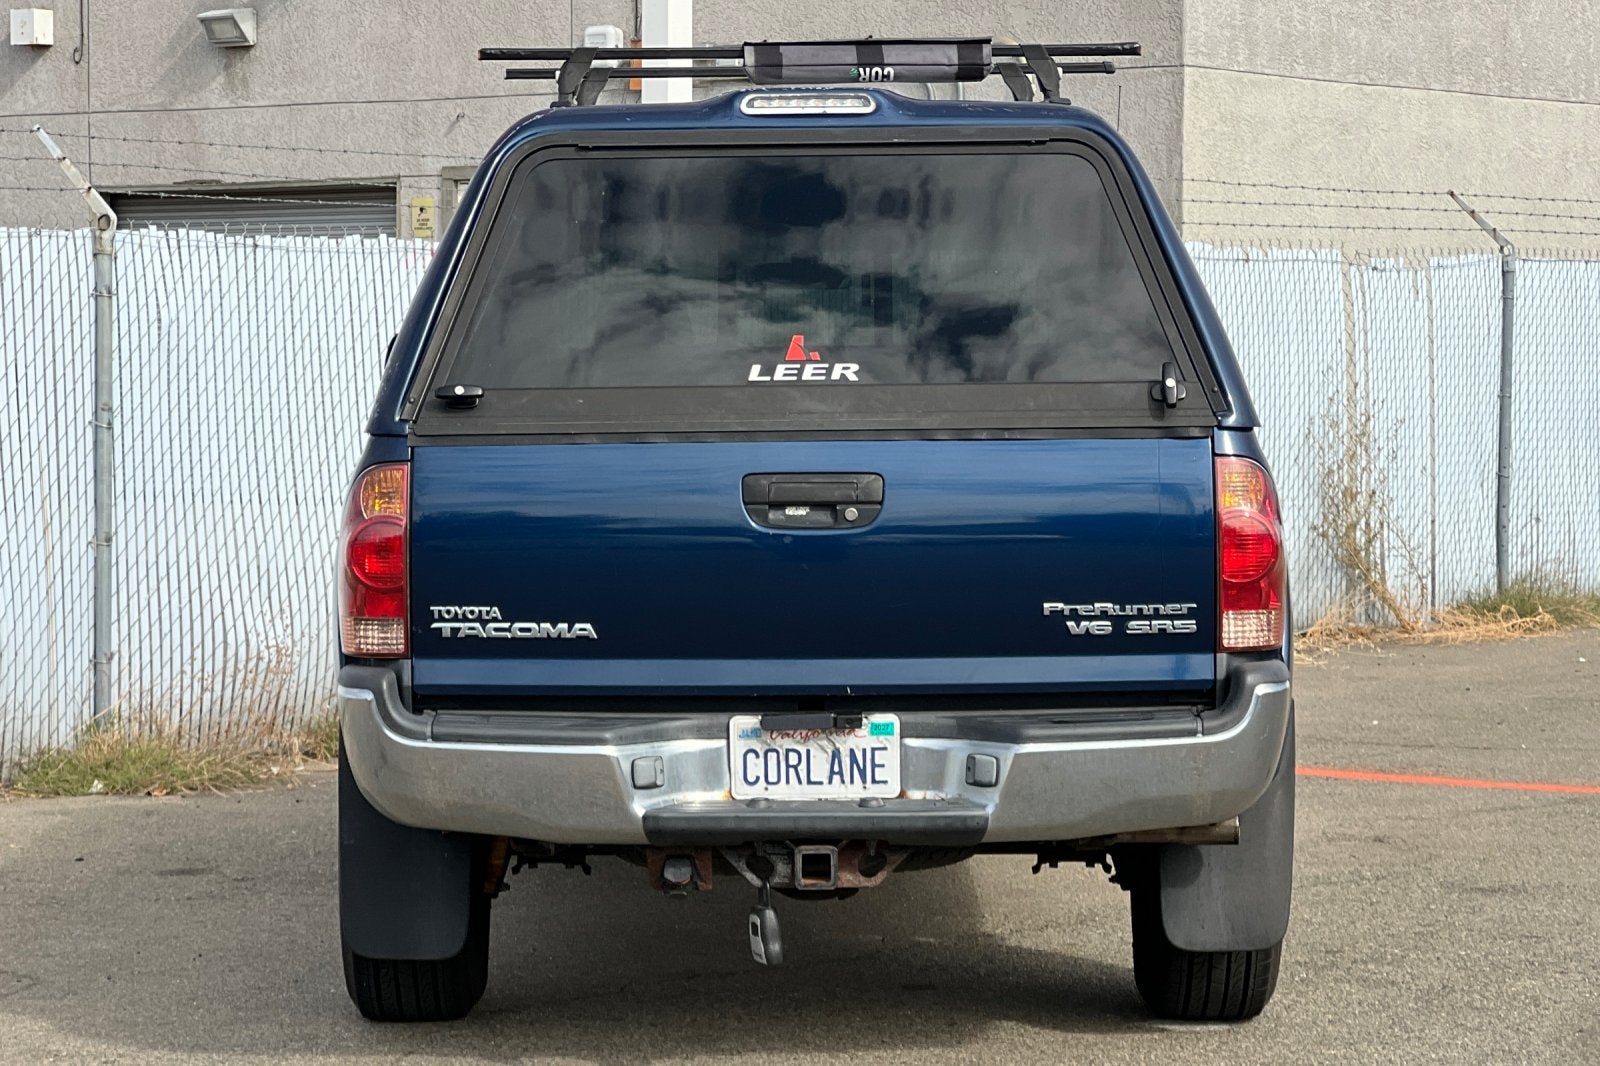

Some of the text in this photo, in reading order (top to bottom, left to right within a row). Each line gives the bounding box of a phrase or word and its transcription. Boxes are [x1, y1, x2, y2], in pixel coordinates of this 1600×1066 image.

[858, 66, 895, 82] COR
[747, 362, 860, 382] LEER
[429, 606, 502, 620] TOYOTA
[1043, 602, 1198, 616] PreRunner
[430, 622, 598, 640] TACOMA
[1066, 619, 1198, 636] V6 SR5
[742, 746, 889, 786] CORLANE
